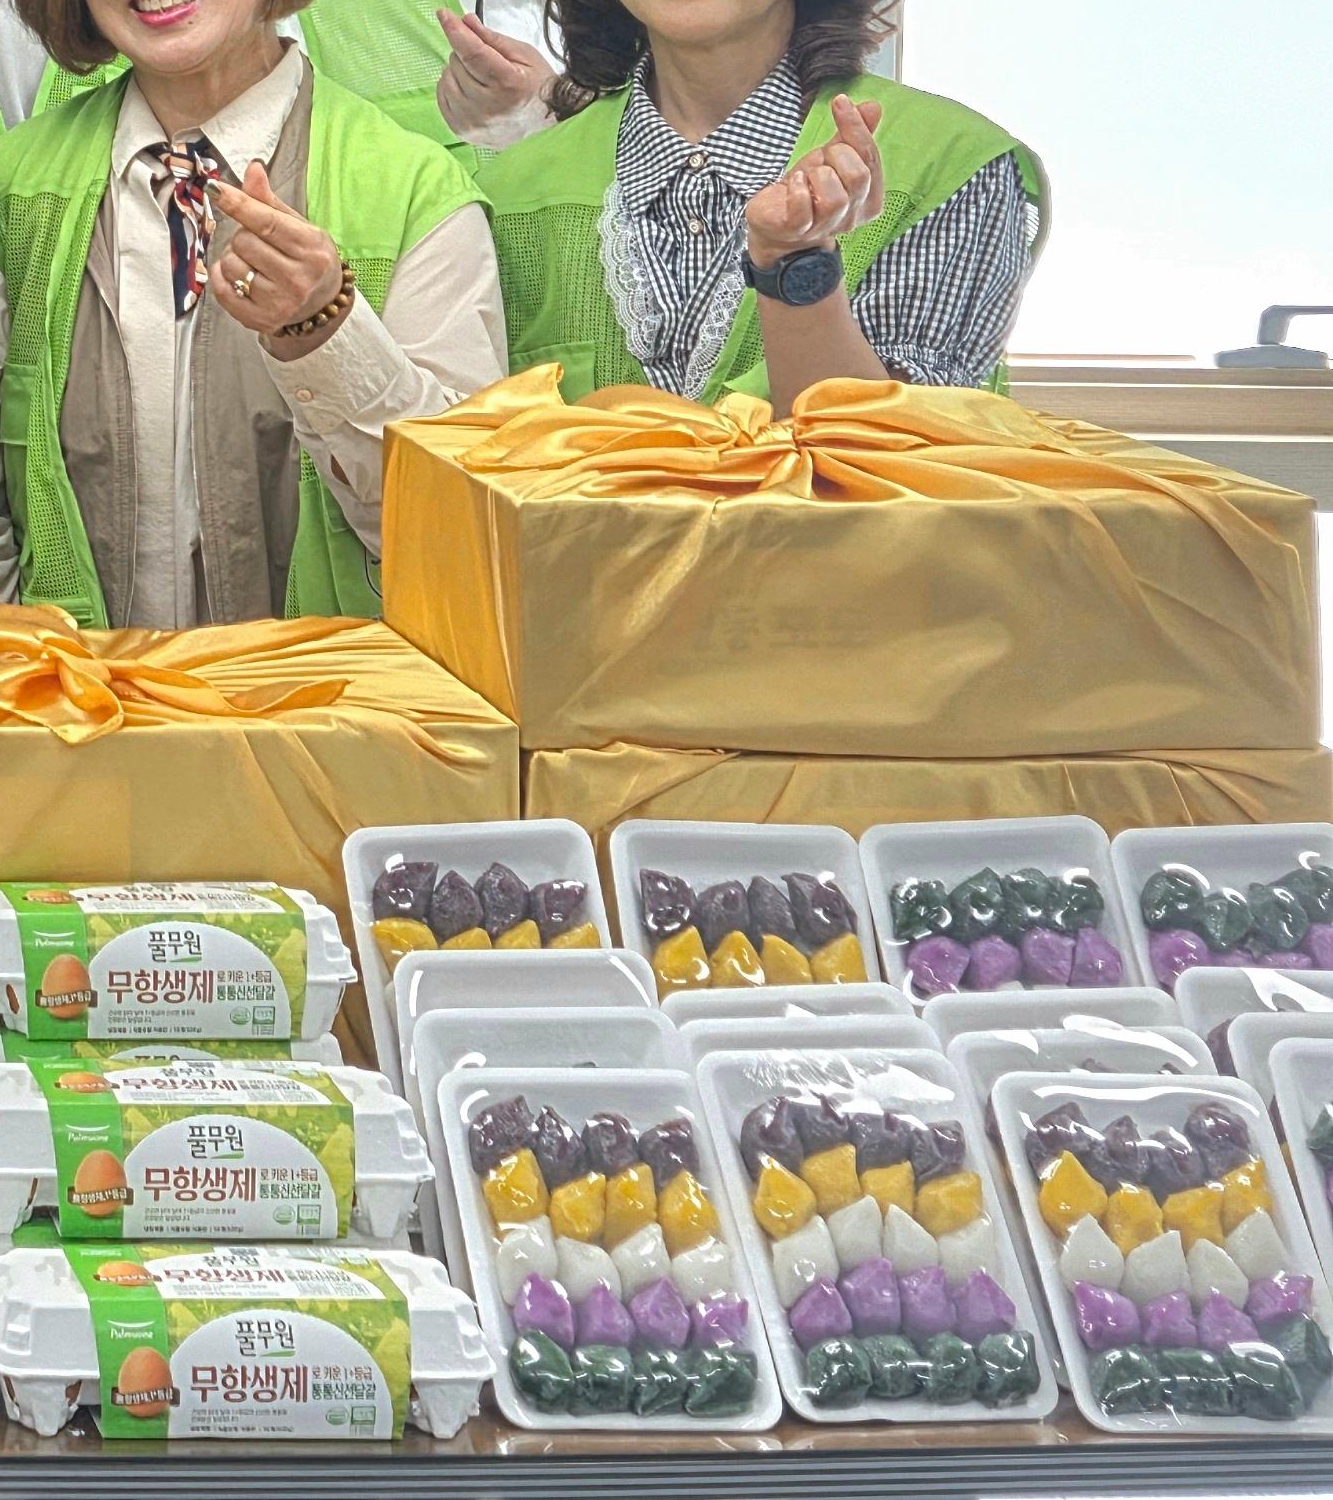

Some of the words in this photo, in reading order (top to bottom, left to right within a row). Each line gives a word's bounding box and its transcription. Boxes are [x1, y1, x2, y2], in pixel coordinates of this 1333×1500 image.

[148, 930, 202, 963] 풀무원
[107, 969, 214, 1004] 무항생제
[187, 1125, 244, 1160] 풀무원
[143, 1166, 257, 1203] 무항생제
[235, 1318, 296, 1357] 풀무원
[190, 1364, 308, 1404] 무항생제
